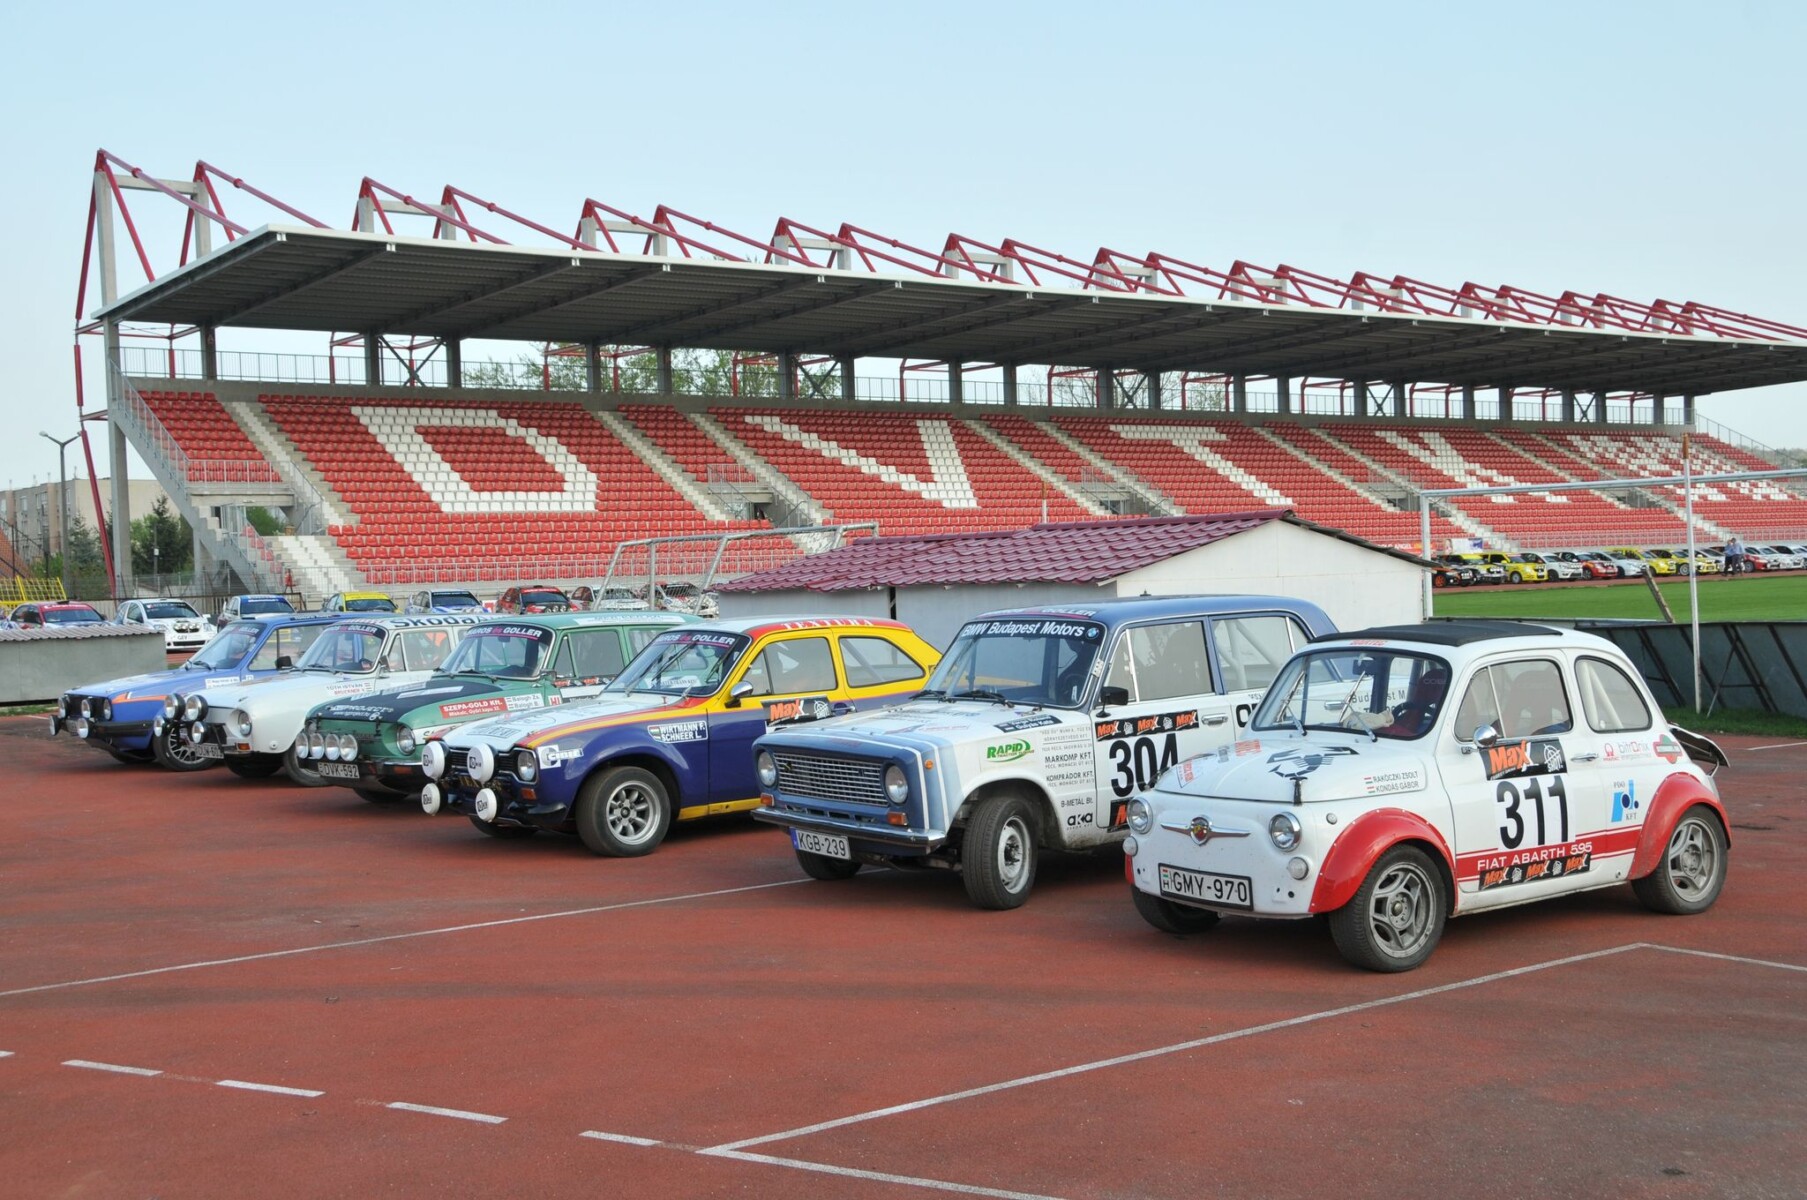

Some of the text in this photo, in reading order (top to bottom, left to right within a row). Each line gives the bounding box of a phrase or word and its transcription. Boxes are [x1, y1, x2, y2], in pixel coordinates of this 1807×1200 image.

[502, 626, 542, 637] GOLLER
[961, 621, 1085, 637] BMW Budapest Motors
[692, 634, 735, 645] GOLLER
[661, 731, 694, 742] SCHNEER
[1045, 753, 1078, 763] MARKOMP
[1497, 775, 1569, 849] 311
[799, 831, 846, 857] KGB-239
[1477, 842, 1593, 871] FIAT ABARTH 595
[1173, 867, 1247, 903] GMY-970
